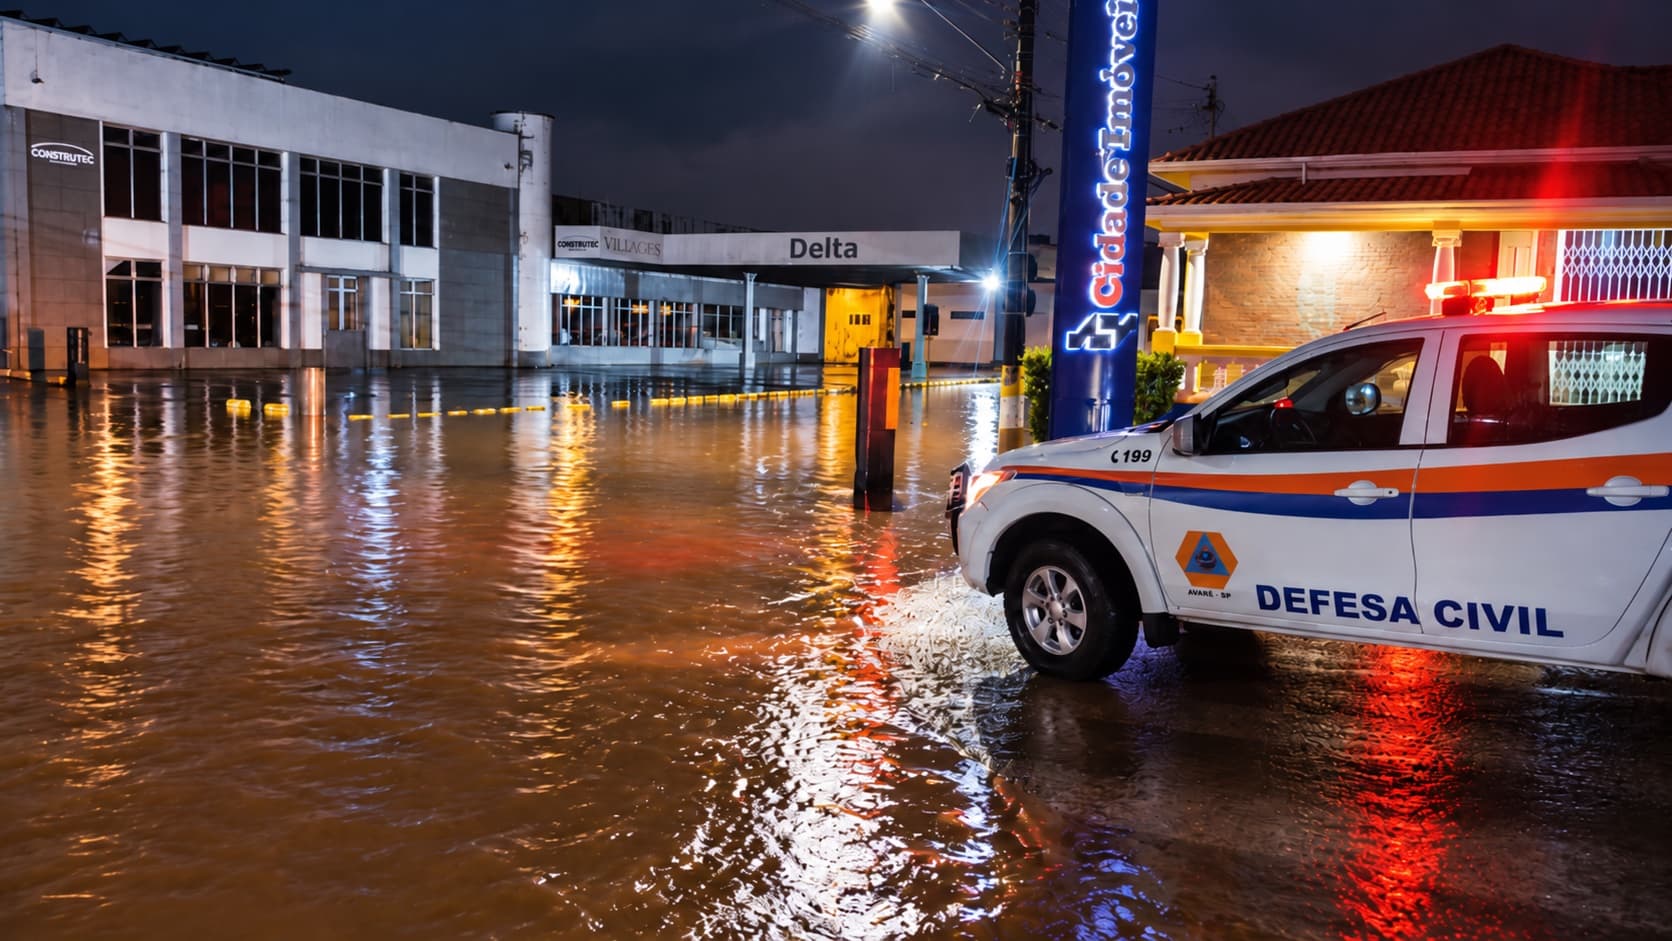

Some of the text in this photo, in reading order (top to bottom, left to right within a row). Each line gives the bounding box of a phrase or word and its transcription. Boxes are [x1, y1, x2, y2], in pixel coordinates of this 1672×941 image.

[31, 148, 94, 164] CONSTRUTEC
[1090, 157, 1130, 308] Cidade
[557, 240, 599, 249] CONSTRUTEC
[603, 236, 661, 257] VILLAGES
[790, 236, 858, 259] Delta
[1124, 449, 1152, 463] 199
[1256, 584, 1565, 638] DEFESA CIVIL
